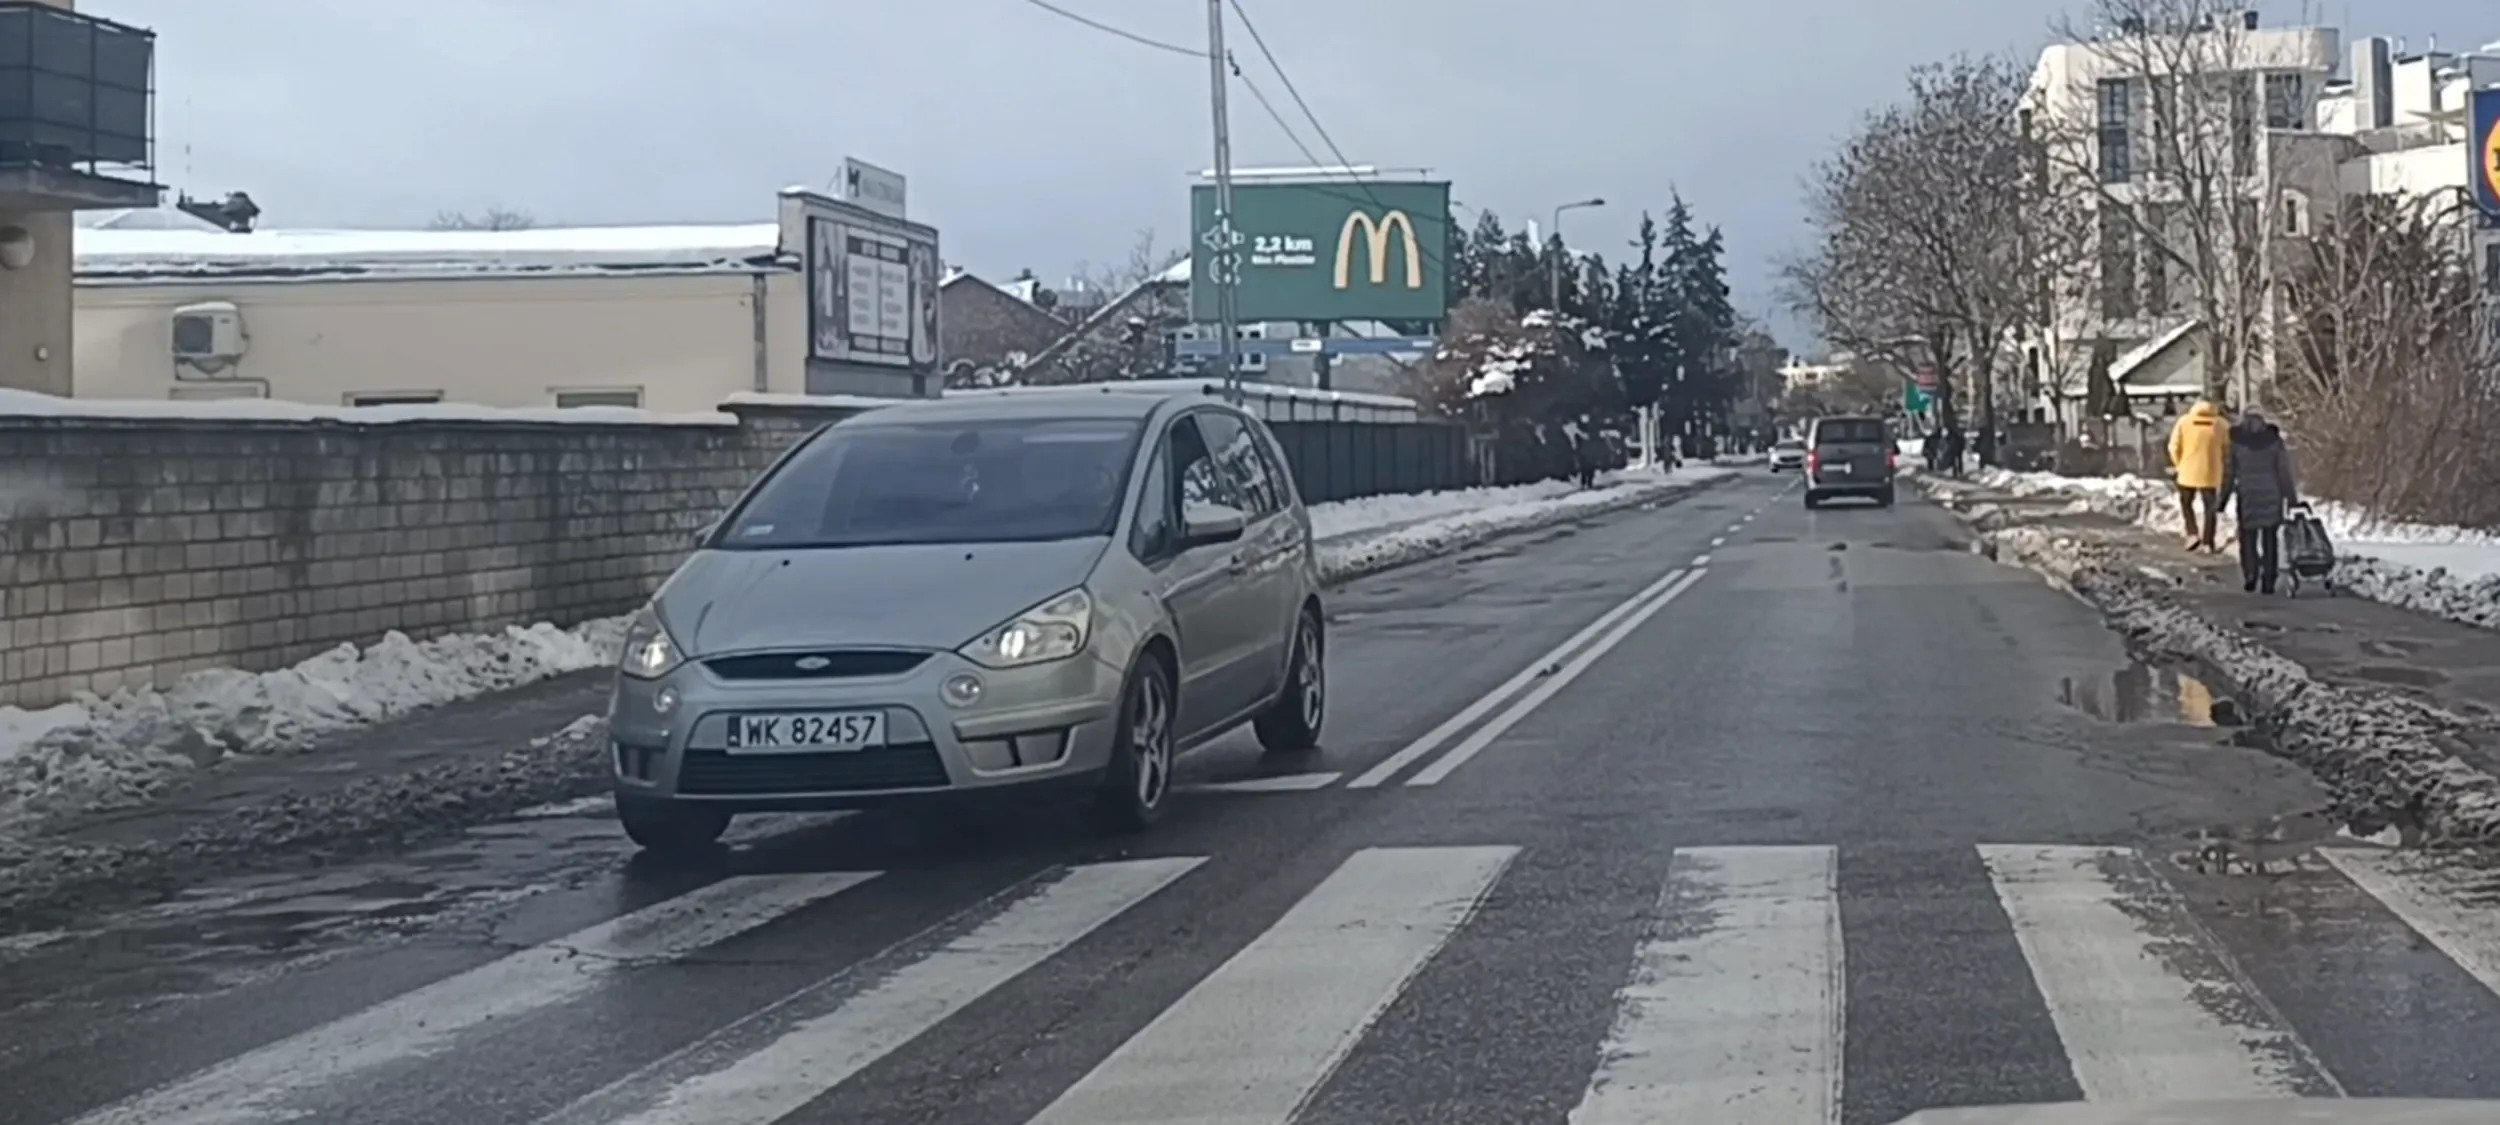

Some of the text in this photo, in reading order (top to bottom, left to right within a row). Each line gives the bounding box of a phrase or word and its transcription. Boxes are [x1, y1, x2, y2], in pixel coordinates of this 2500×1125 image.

[1254, 236, 1313, 253] 2,2 km
[746, 715, 876, 745] WK 82457
